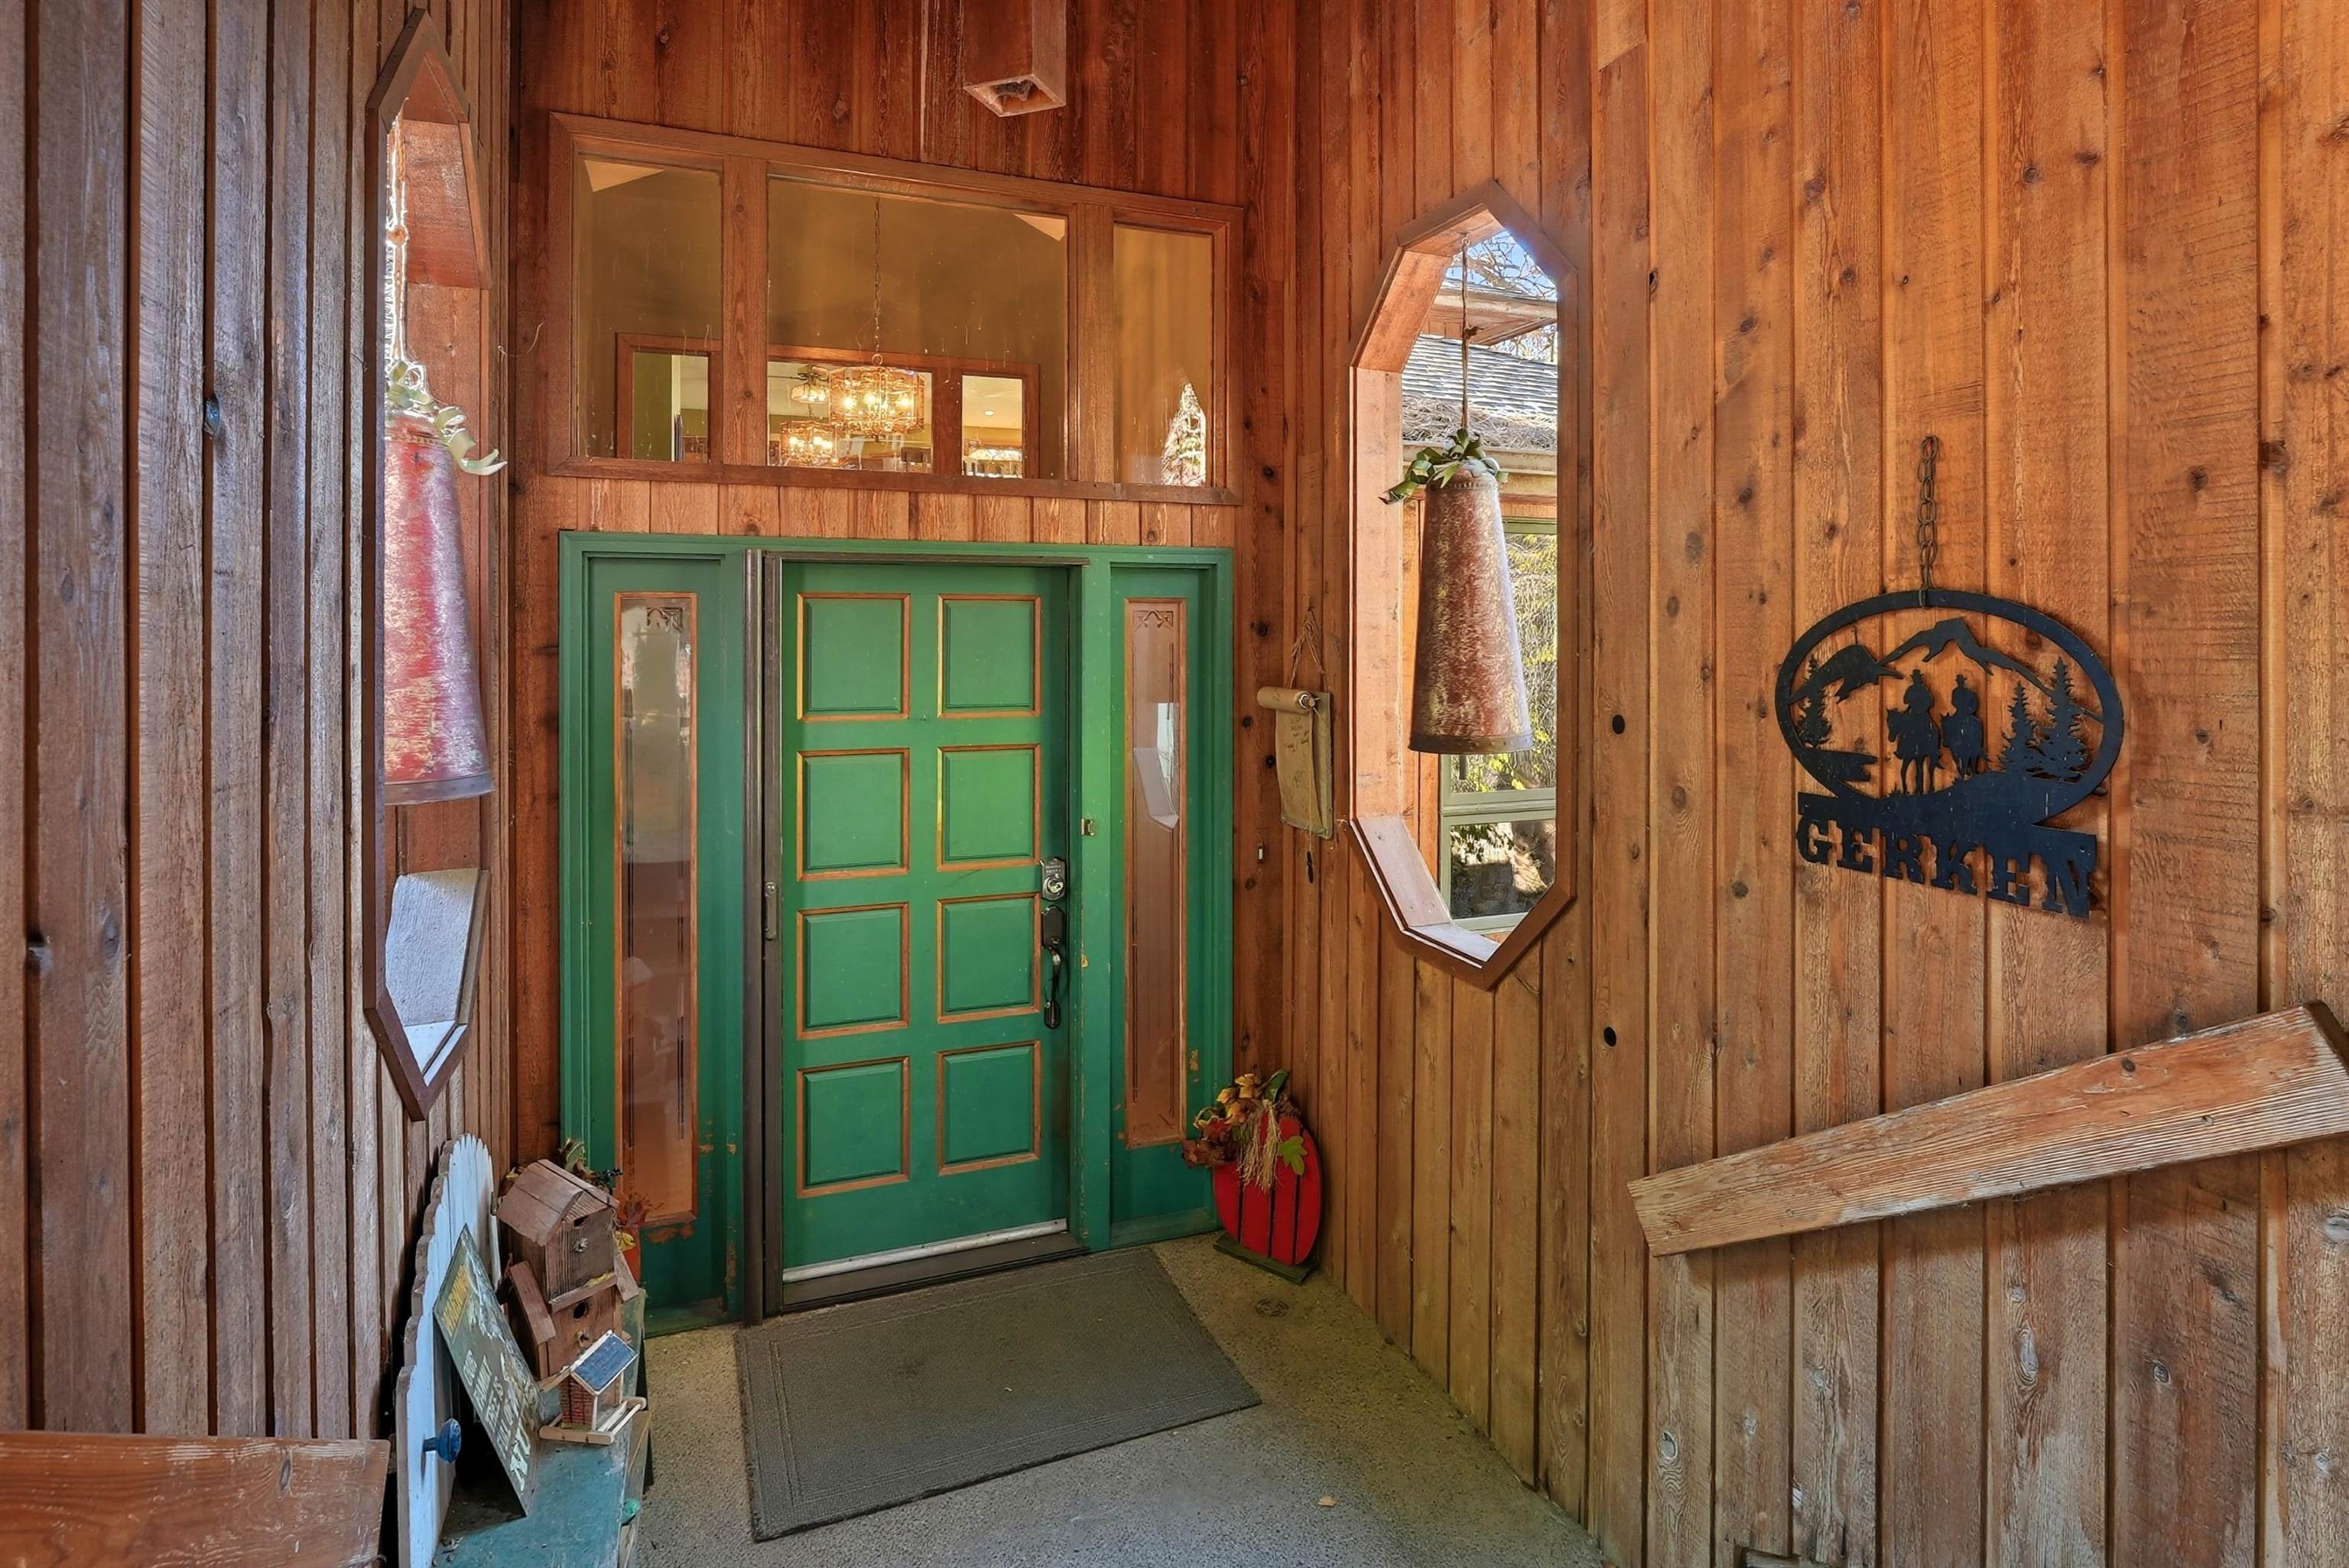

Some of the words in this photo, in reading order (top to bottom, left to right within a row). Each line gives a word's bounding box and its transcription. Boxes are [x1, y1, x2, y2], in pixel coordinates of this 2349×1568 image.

[1796, 812, 2097, 918] GERKEN
[473, 1355, 492, 1413] FAMILY
[485, 1389, 500, 1434] TREE
[494, 1375, 504, 1402] IS
